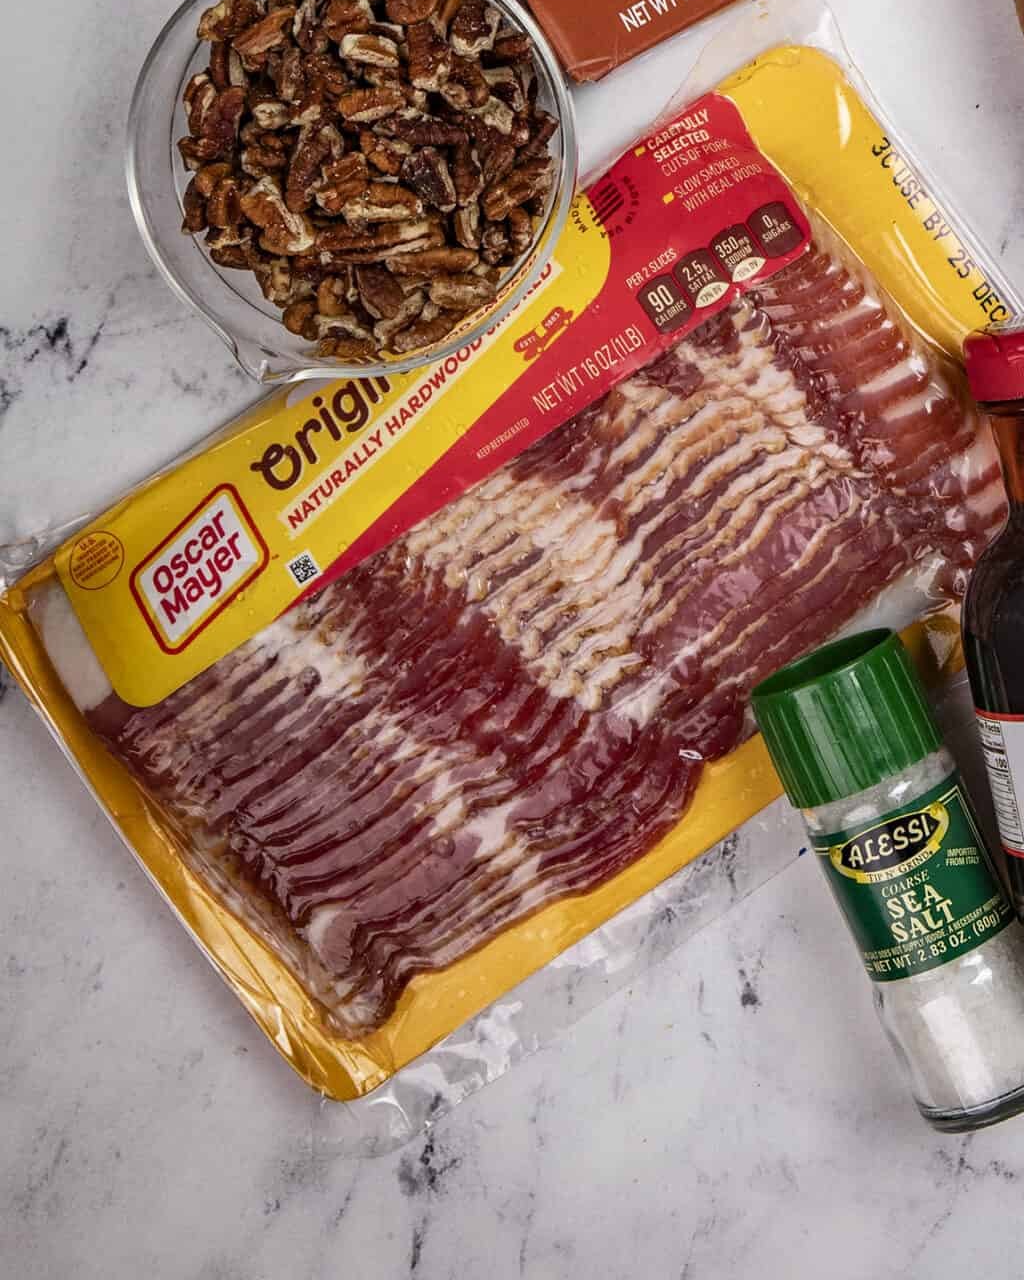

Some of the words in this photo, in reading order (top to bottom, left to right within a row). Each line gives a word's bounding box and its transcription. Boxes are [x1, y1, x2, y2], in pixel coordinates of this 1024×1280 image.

[618, 0, 652, 33] NET
[647, 108, 711, 150] CAREFULLY
[653, 129, 710, 163] SELECTED
[661, 155, 688, 177] CUTS
[687, 147, 702, 165] OF
[703, 138, 733, 156] PORK
[673, 174, 702, 199] SLOW
[699, 156, 741, 182] SMOKED
[682, 190, 710, 213] WITH
[708, 176, 734, 202] REAL
[733, 162, 763, 184] WOOD
[761, 221, 793, 243] SUGARS
[892, 168, 929, 210] USE
[922, 211, 952, 241] BY
[947, 249, 976, 280] 25
[971, 282, 1007, 323] DEC
[625, 271, 642, 290] PER
[641, 267, 651, 279] 2
[649, 247, 679, 272] SLICES
[724, 245, 753, 268] SODIUM
[647, 284, 675, 314] 90
[688, 279, 703, 294] SAT
[702, 269, 717, 284] FAT
[654, 299, 689, 327] CALORIES
[532, 382, 563, 415] NET
[556, 367, 584, 397] WT
[580, 358, 596, 381] 16
[595, 344, 618, 371] OZ
[611, 324, 647, 362] (1LB)
[250, 371, 391, 491] Origi
[476, 442, 491, 460] KEEP
[489, 417, 530, 450] REFRIGERATED
[286, 429, 385, 530] NATURALLY
[160, 532, 246, 625] Mayer
[848, 815, 931, 868] ALESSI
[945, 858, 965, 867] FROM
[966, 856, 981, 865] ITALY
[946, 847, 977, 857] IMPORTED
[881, 869, 930, 898] COARSE
[886, 884, 944, 920] SEA
[873, 959, 892, 973] NET
[892, 954, 916, 970] WT.
[918, 940, 947, 961] 2.83
[949, 931, 972, 948] OZ.
[972, 910, 1001, 936] (80g)
[890, 900, 955, 943] SALT
